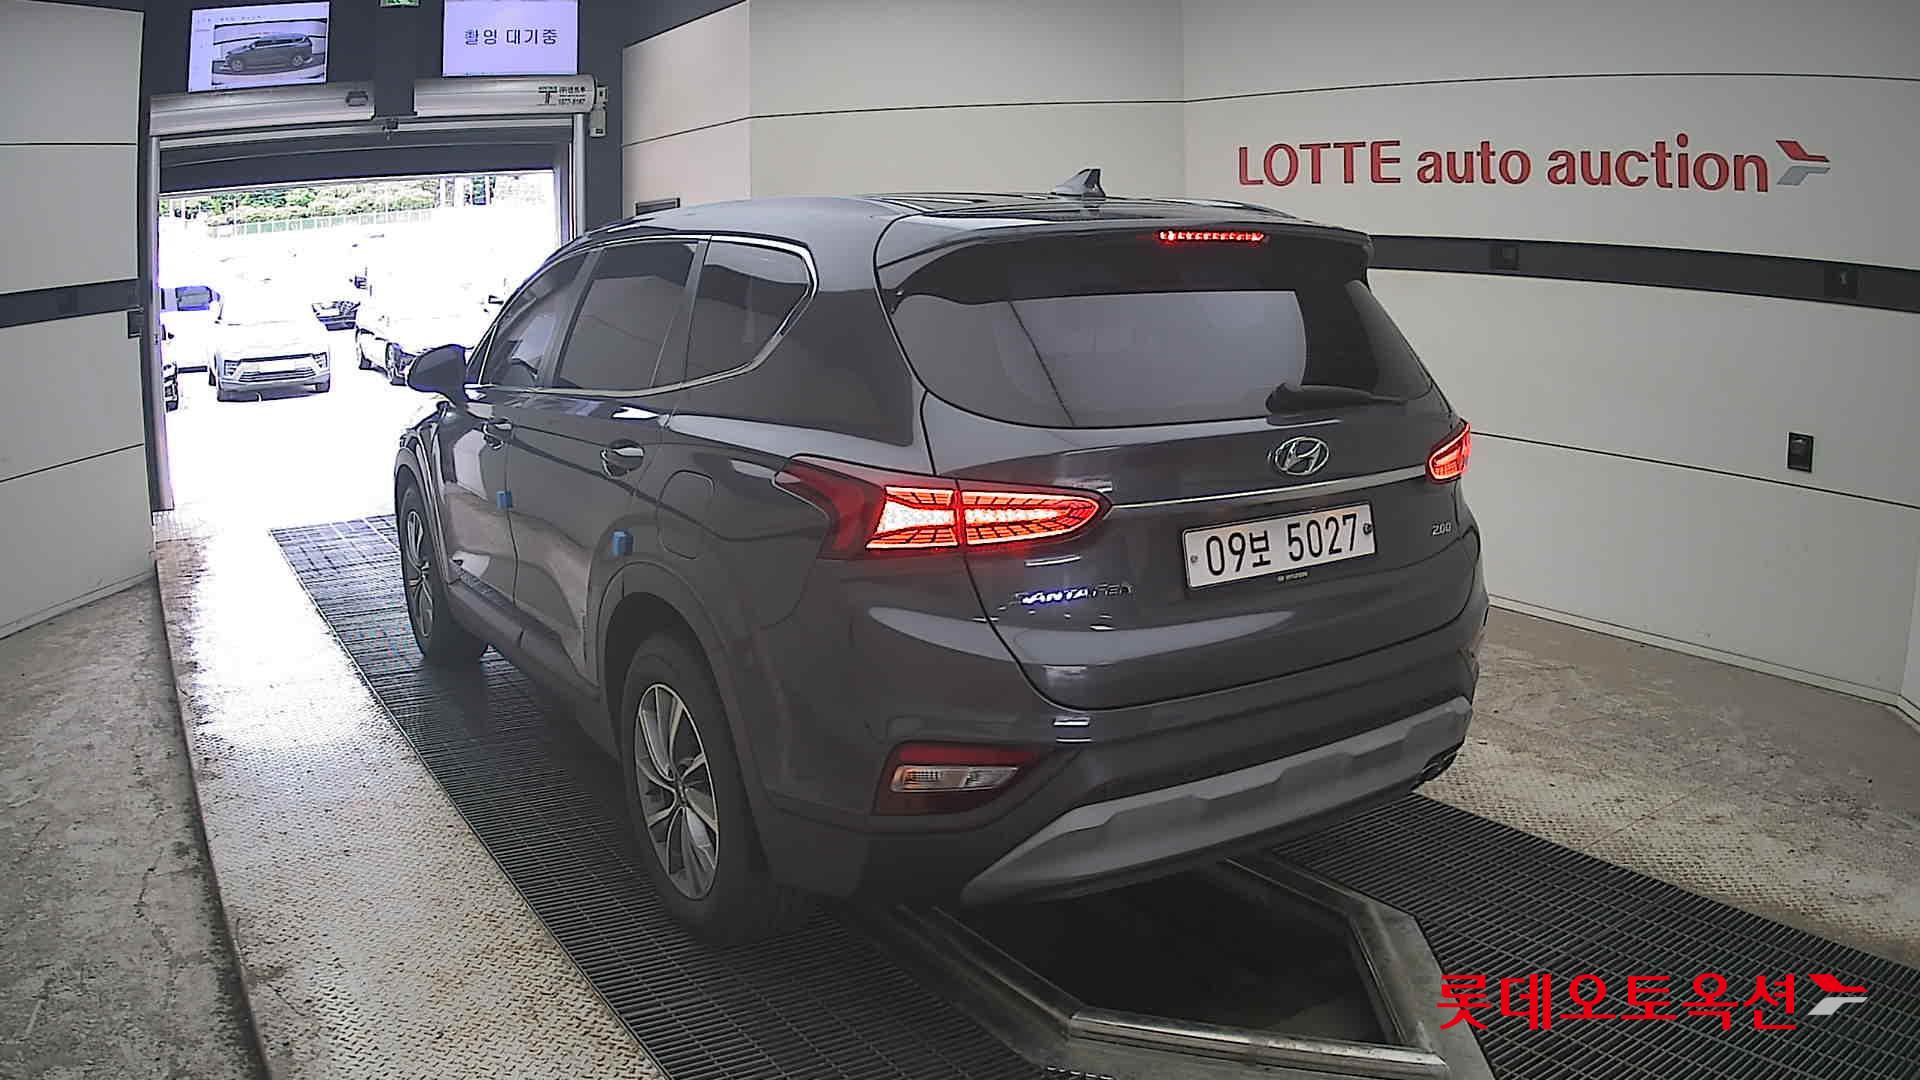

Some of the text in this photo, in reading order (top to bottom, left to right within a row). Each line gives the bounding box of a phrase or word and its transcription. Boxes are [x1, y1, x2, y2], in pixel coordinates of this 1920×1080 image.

[505, 28, 557, 45] 대기중
[1239, 132, 1770, 192] LOTTE auto auction
[1205, 513, 1358, 576] 09보 5027
